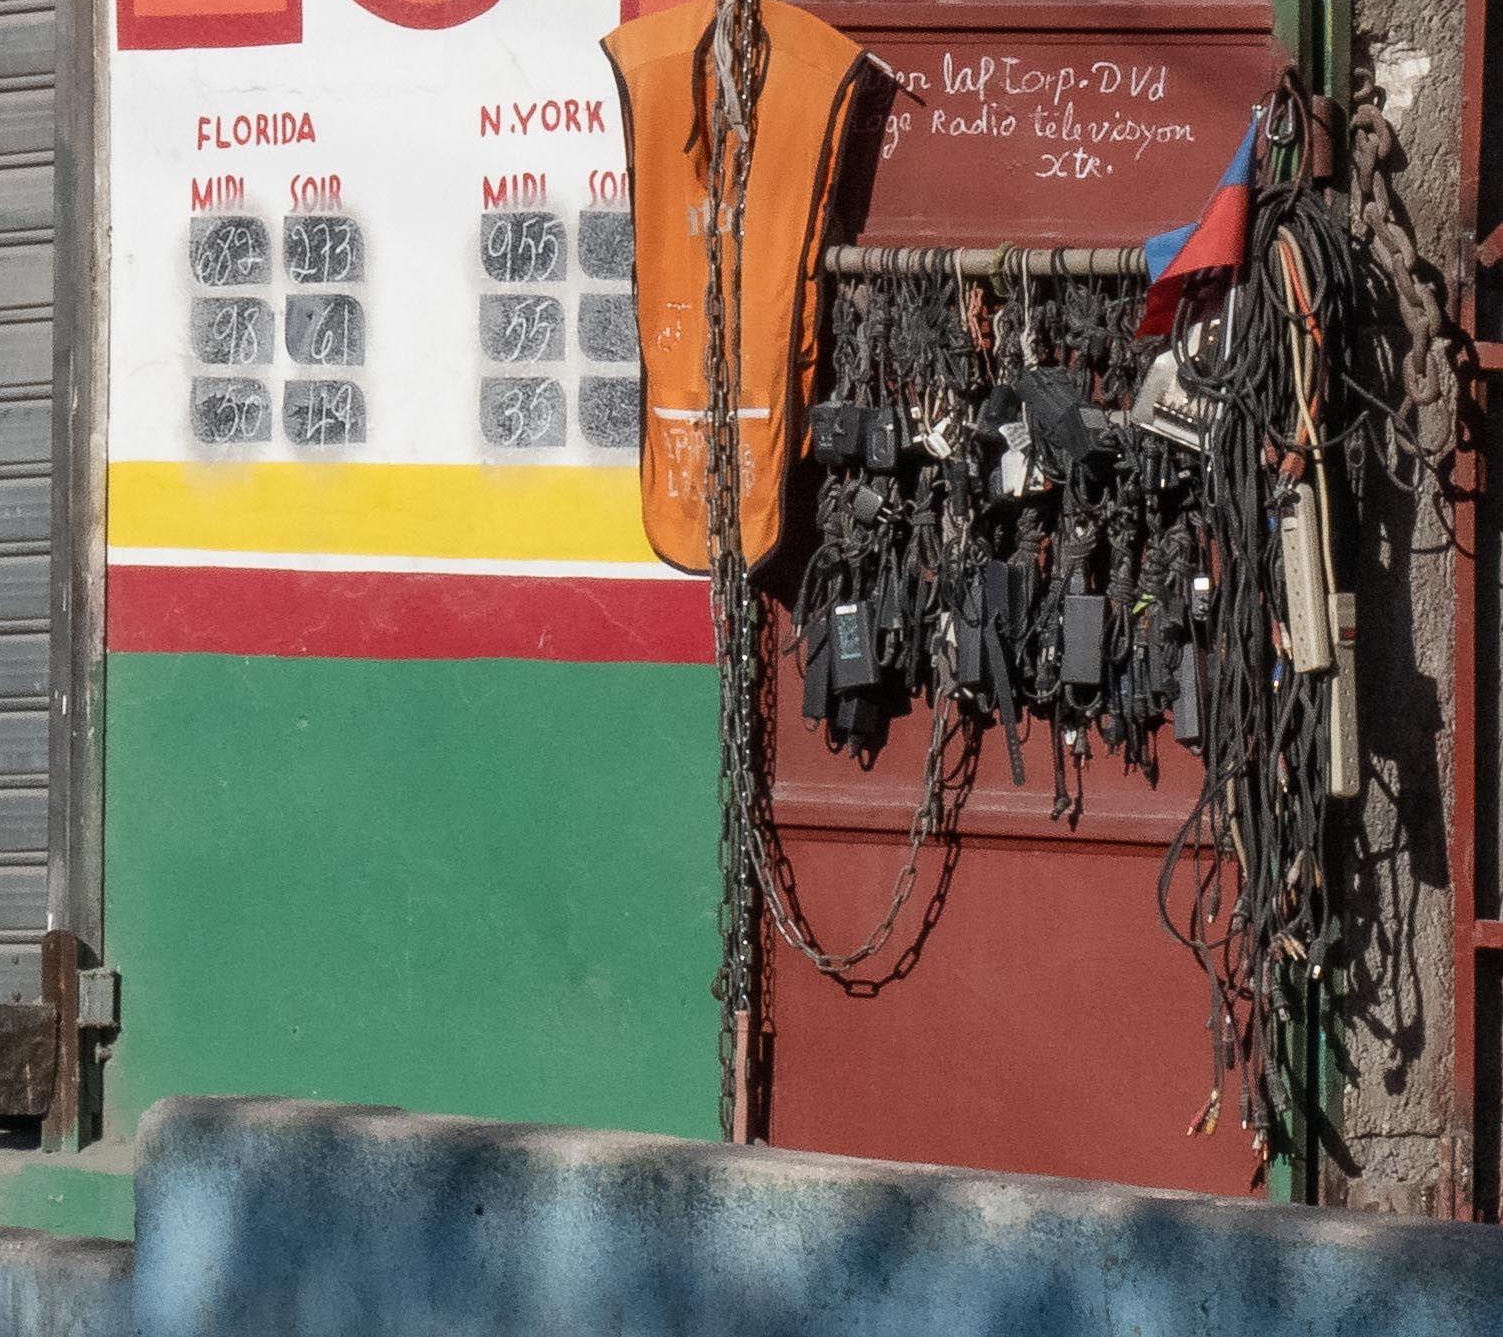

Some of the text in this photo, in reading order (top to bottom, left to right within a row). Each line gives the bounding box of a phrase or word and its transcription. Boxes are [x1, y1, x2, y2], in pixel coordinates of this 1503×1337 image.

[197, 112, 317, 151] FLORIDA
[191, 174, 343, 213] MIDI SOIR
[483, 169, 628, 210] MIDI SOI
[490, 216, 565, 280] 955
[213, 305, 259, 366] 98
